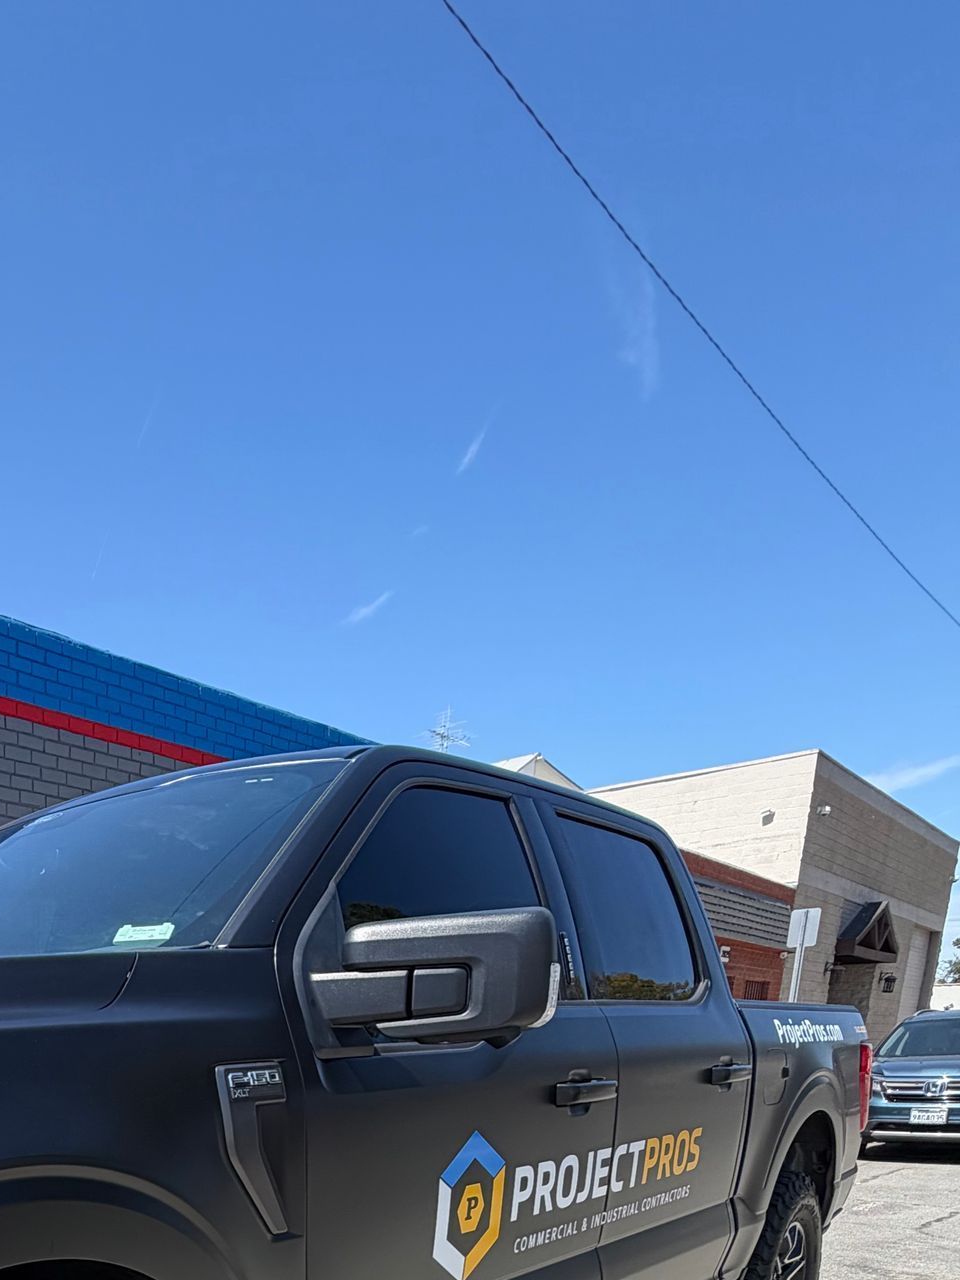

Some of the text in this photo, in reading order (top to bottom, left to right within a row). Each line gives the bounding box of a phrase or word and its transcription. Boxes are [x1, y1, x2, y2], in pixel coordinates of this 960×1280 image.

[773, 1018, 844, 1049] ProjectPros.com
[228, 1070, 282, 1088] F-150
[234, 1088, 250, 1098] XLT
[513, 1184, 691, 1254] COMMERCIAL & INDUSTRIAL CONTRACTORS
